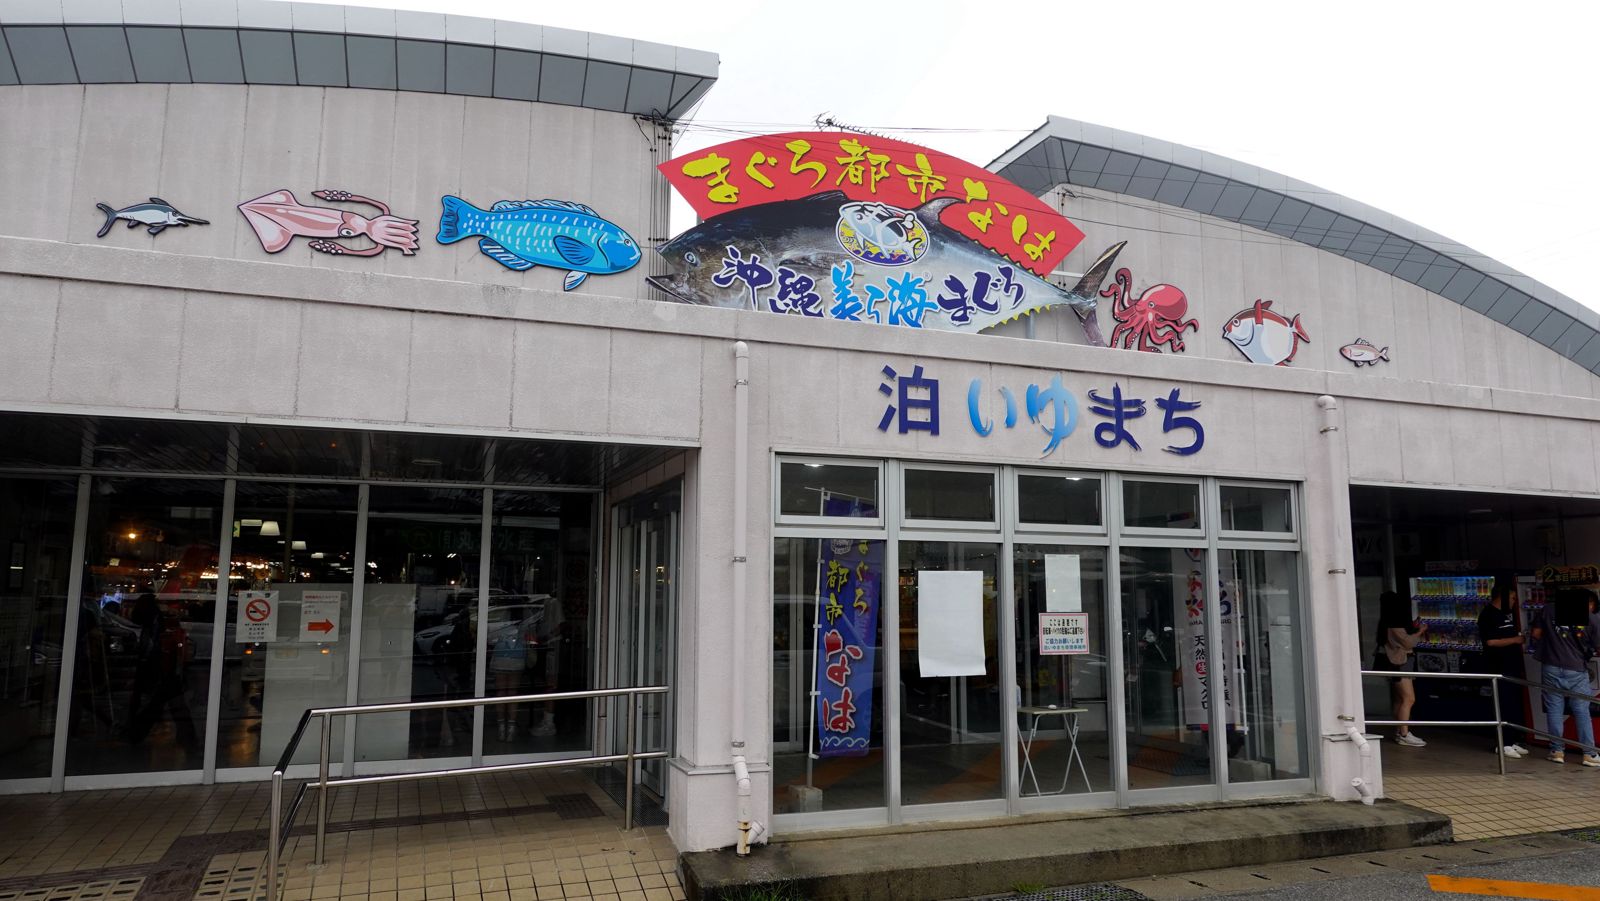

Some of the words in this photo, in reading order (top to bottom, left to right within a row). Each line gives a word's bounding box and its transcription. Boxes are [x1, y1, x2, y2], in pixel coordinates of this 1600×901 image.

[878, 364, 1205, 460] 泊いゆまち
